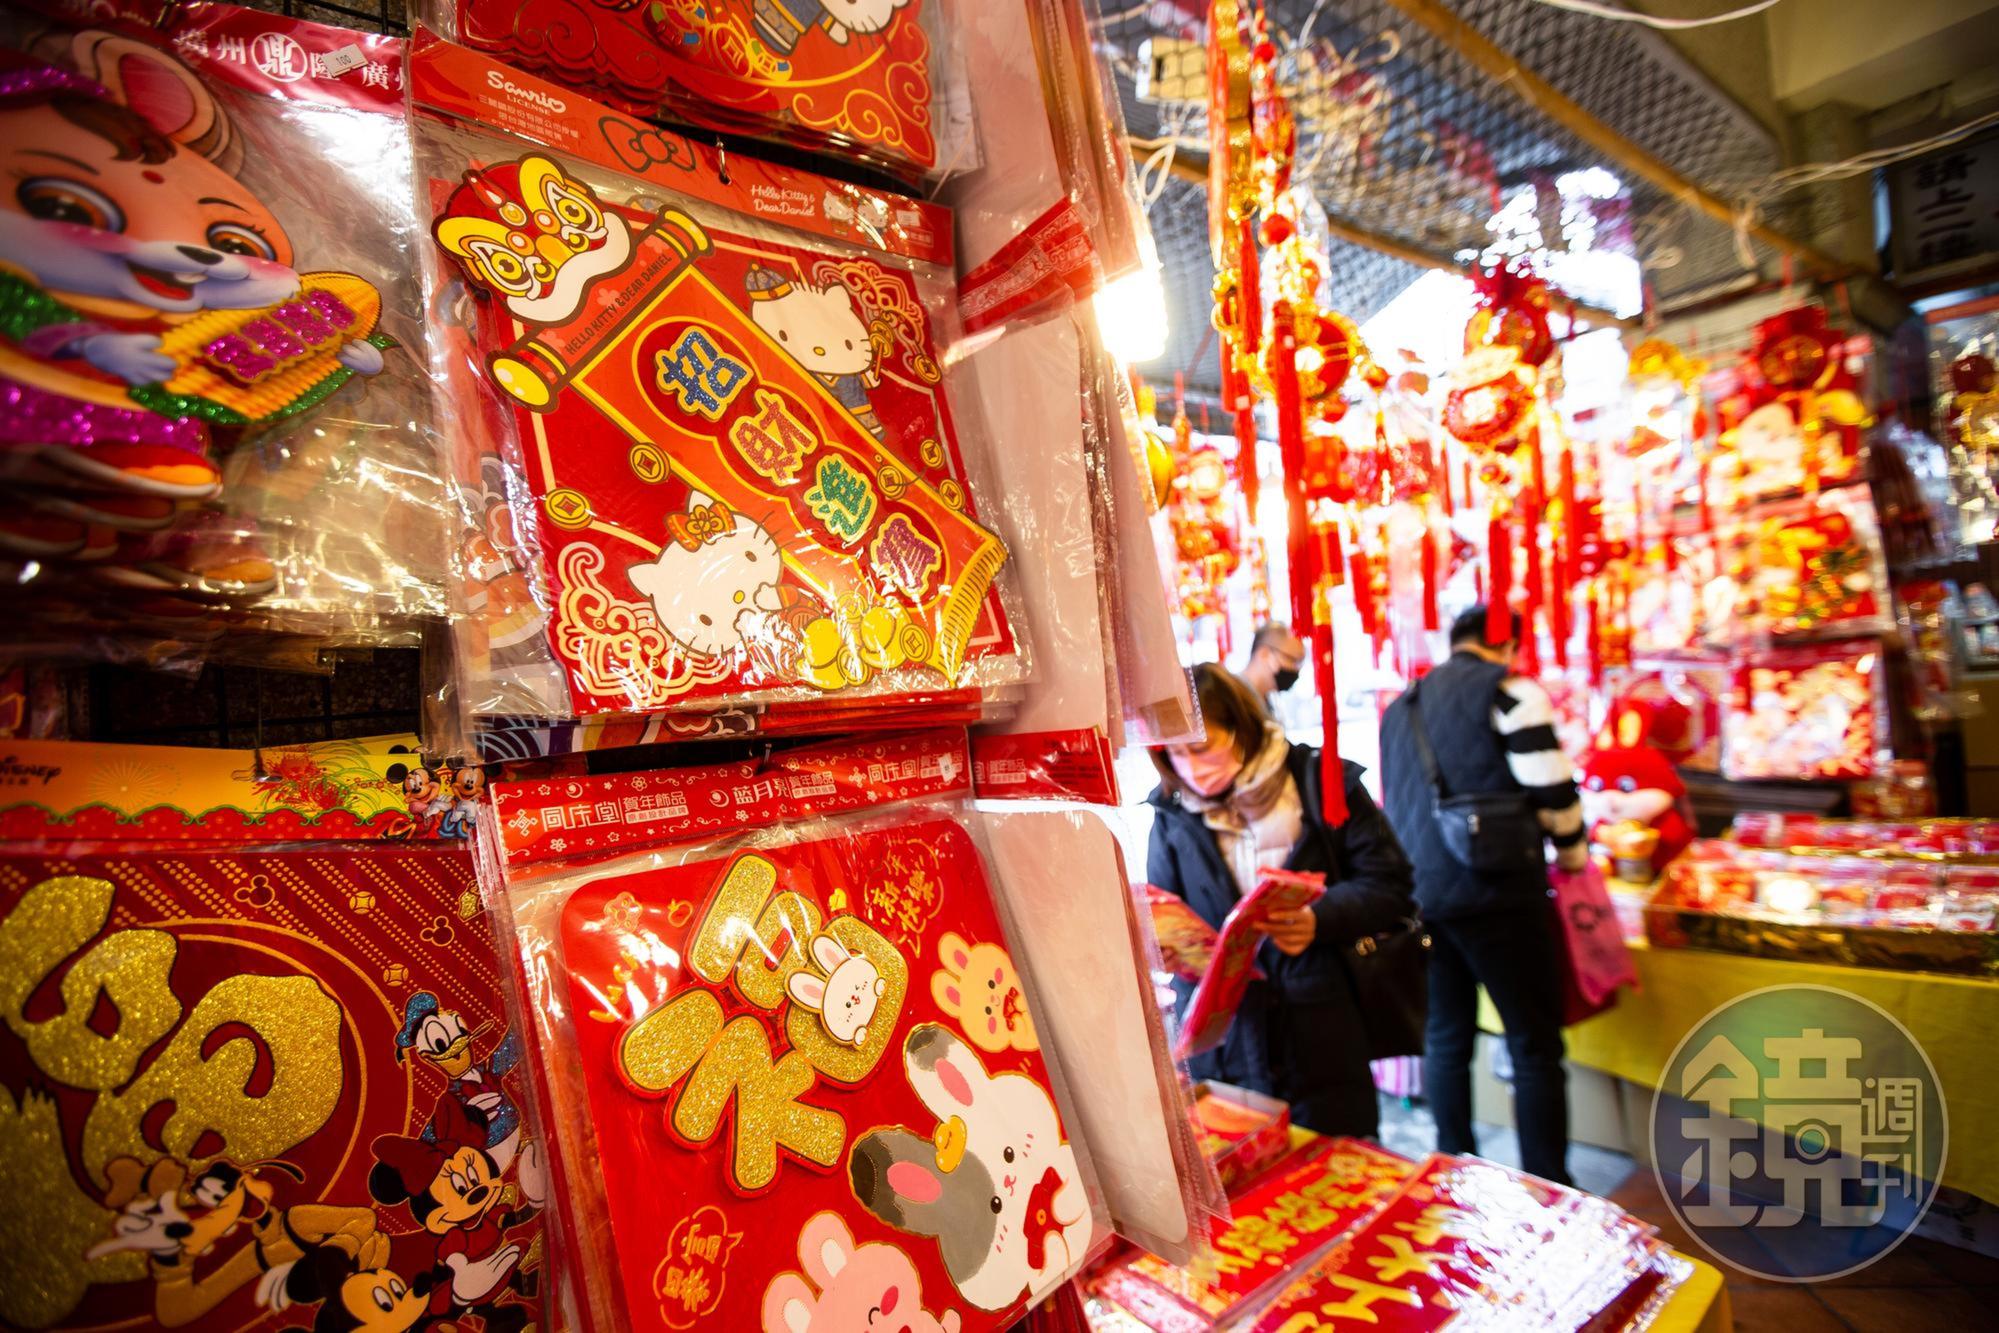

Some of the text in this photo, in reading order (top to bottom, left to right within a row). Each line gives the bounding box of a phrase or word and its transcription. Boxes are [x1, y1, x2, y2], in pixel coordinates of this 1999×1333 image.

[487, 70, 567, 114] Sanrio
[506, 94, 552, 116] LICENSE
[564, 328, 596, 356] HELLO
[591, 304, 618, 330] KITTY
[640, 253, 673, 282] DANIEL
[656, 326, 942, 597] 招財進寶
[622, 790, 688, 813] 賀年飾品
[731, 776, 789, 806] 蓝月亮
[620, 852, 910, 1192] 福
